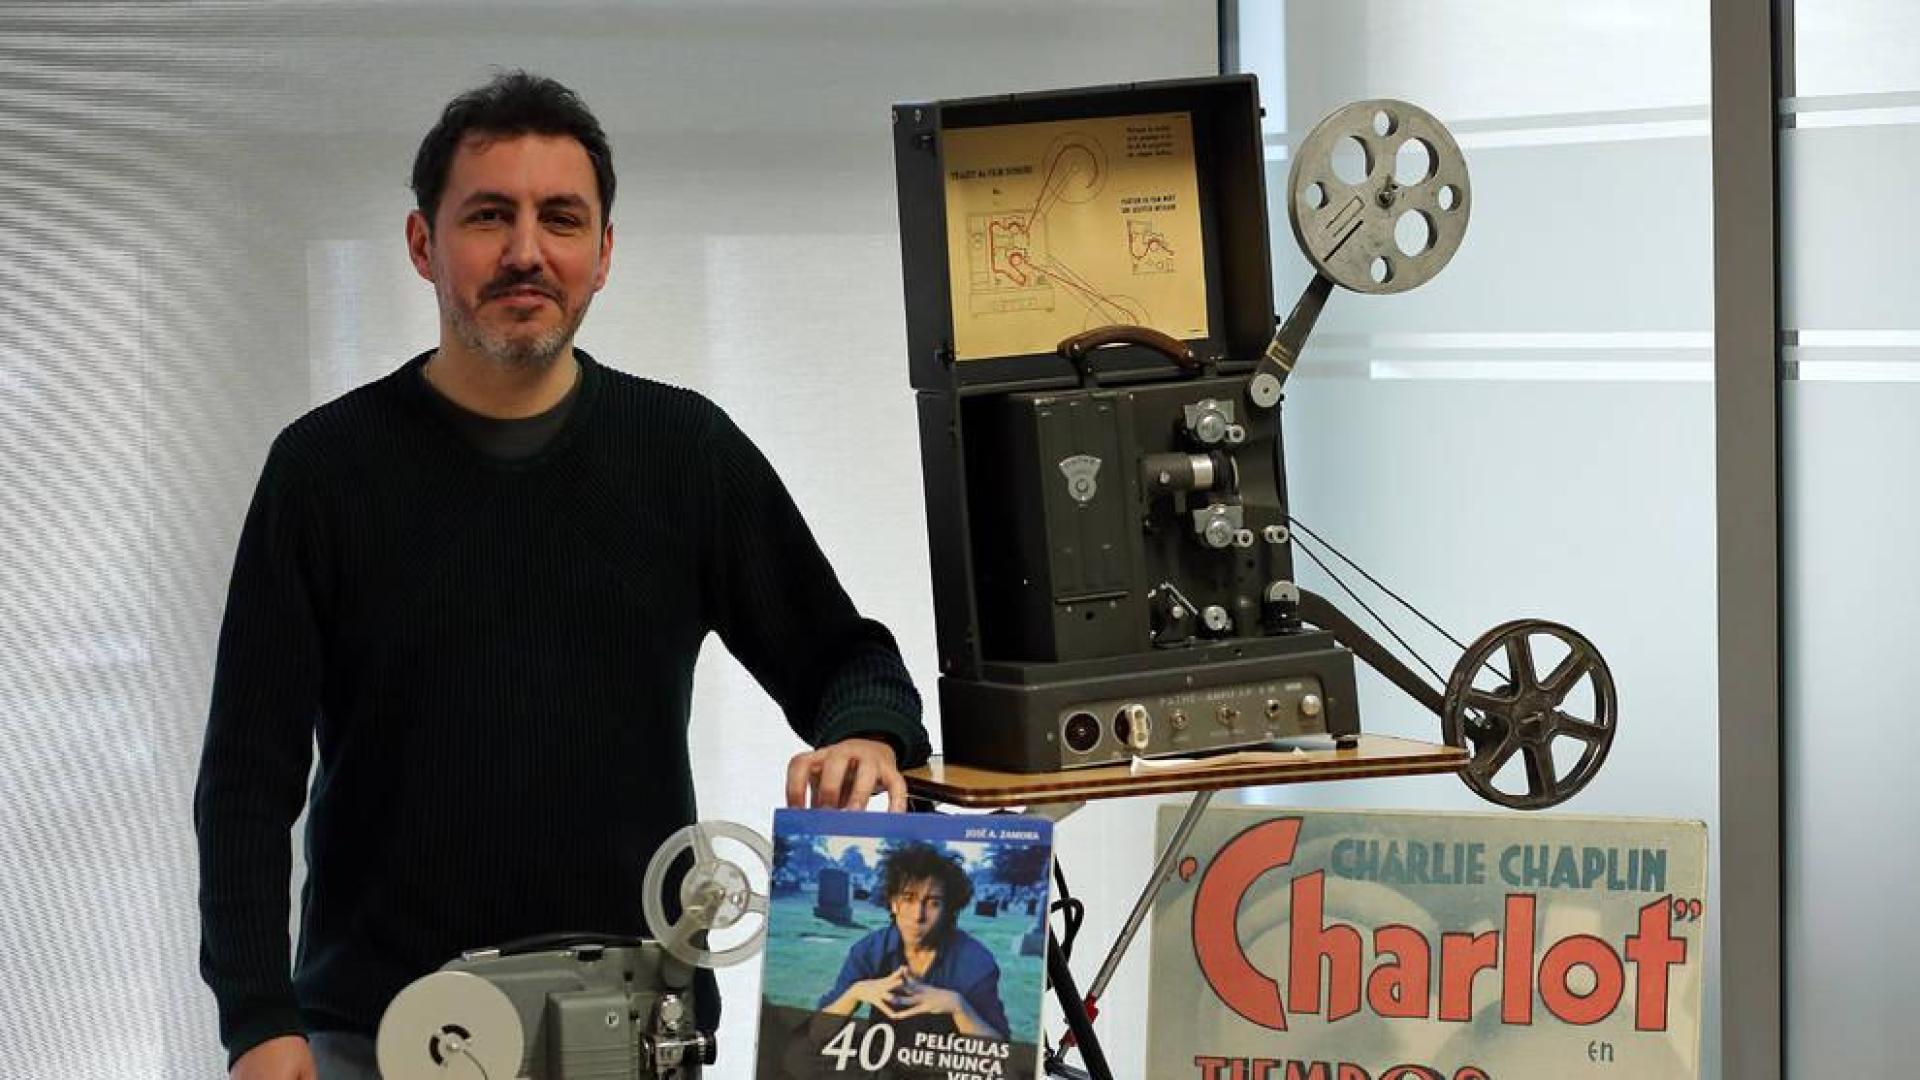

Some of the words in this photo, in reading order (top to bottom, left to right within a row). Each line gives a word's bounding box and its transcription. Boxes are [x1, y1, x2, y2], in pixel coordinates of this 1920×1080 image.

[1000, 829, 1040, 841] ZAMORA
[1331, 838, 1486, 885] CHARLIE
[1499, 844, 1667, 892] CHAPLIN
[821, 1021, 896, 1071] 40
[915, 1031, 1010, 1059] PELÍCULAS
[897, 1048, 935, 1065] QUE
[938, 1053, 1003, 1075] NUNCA
